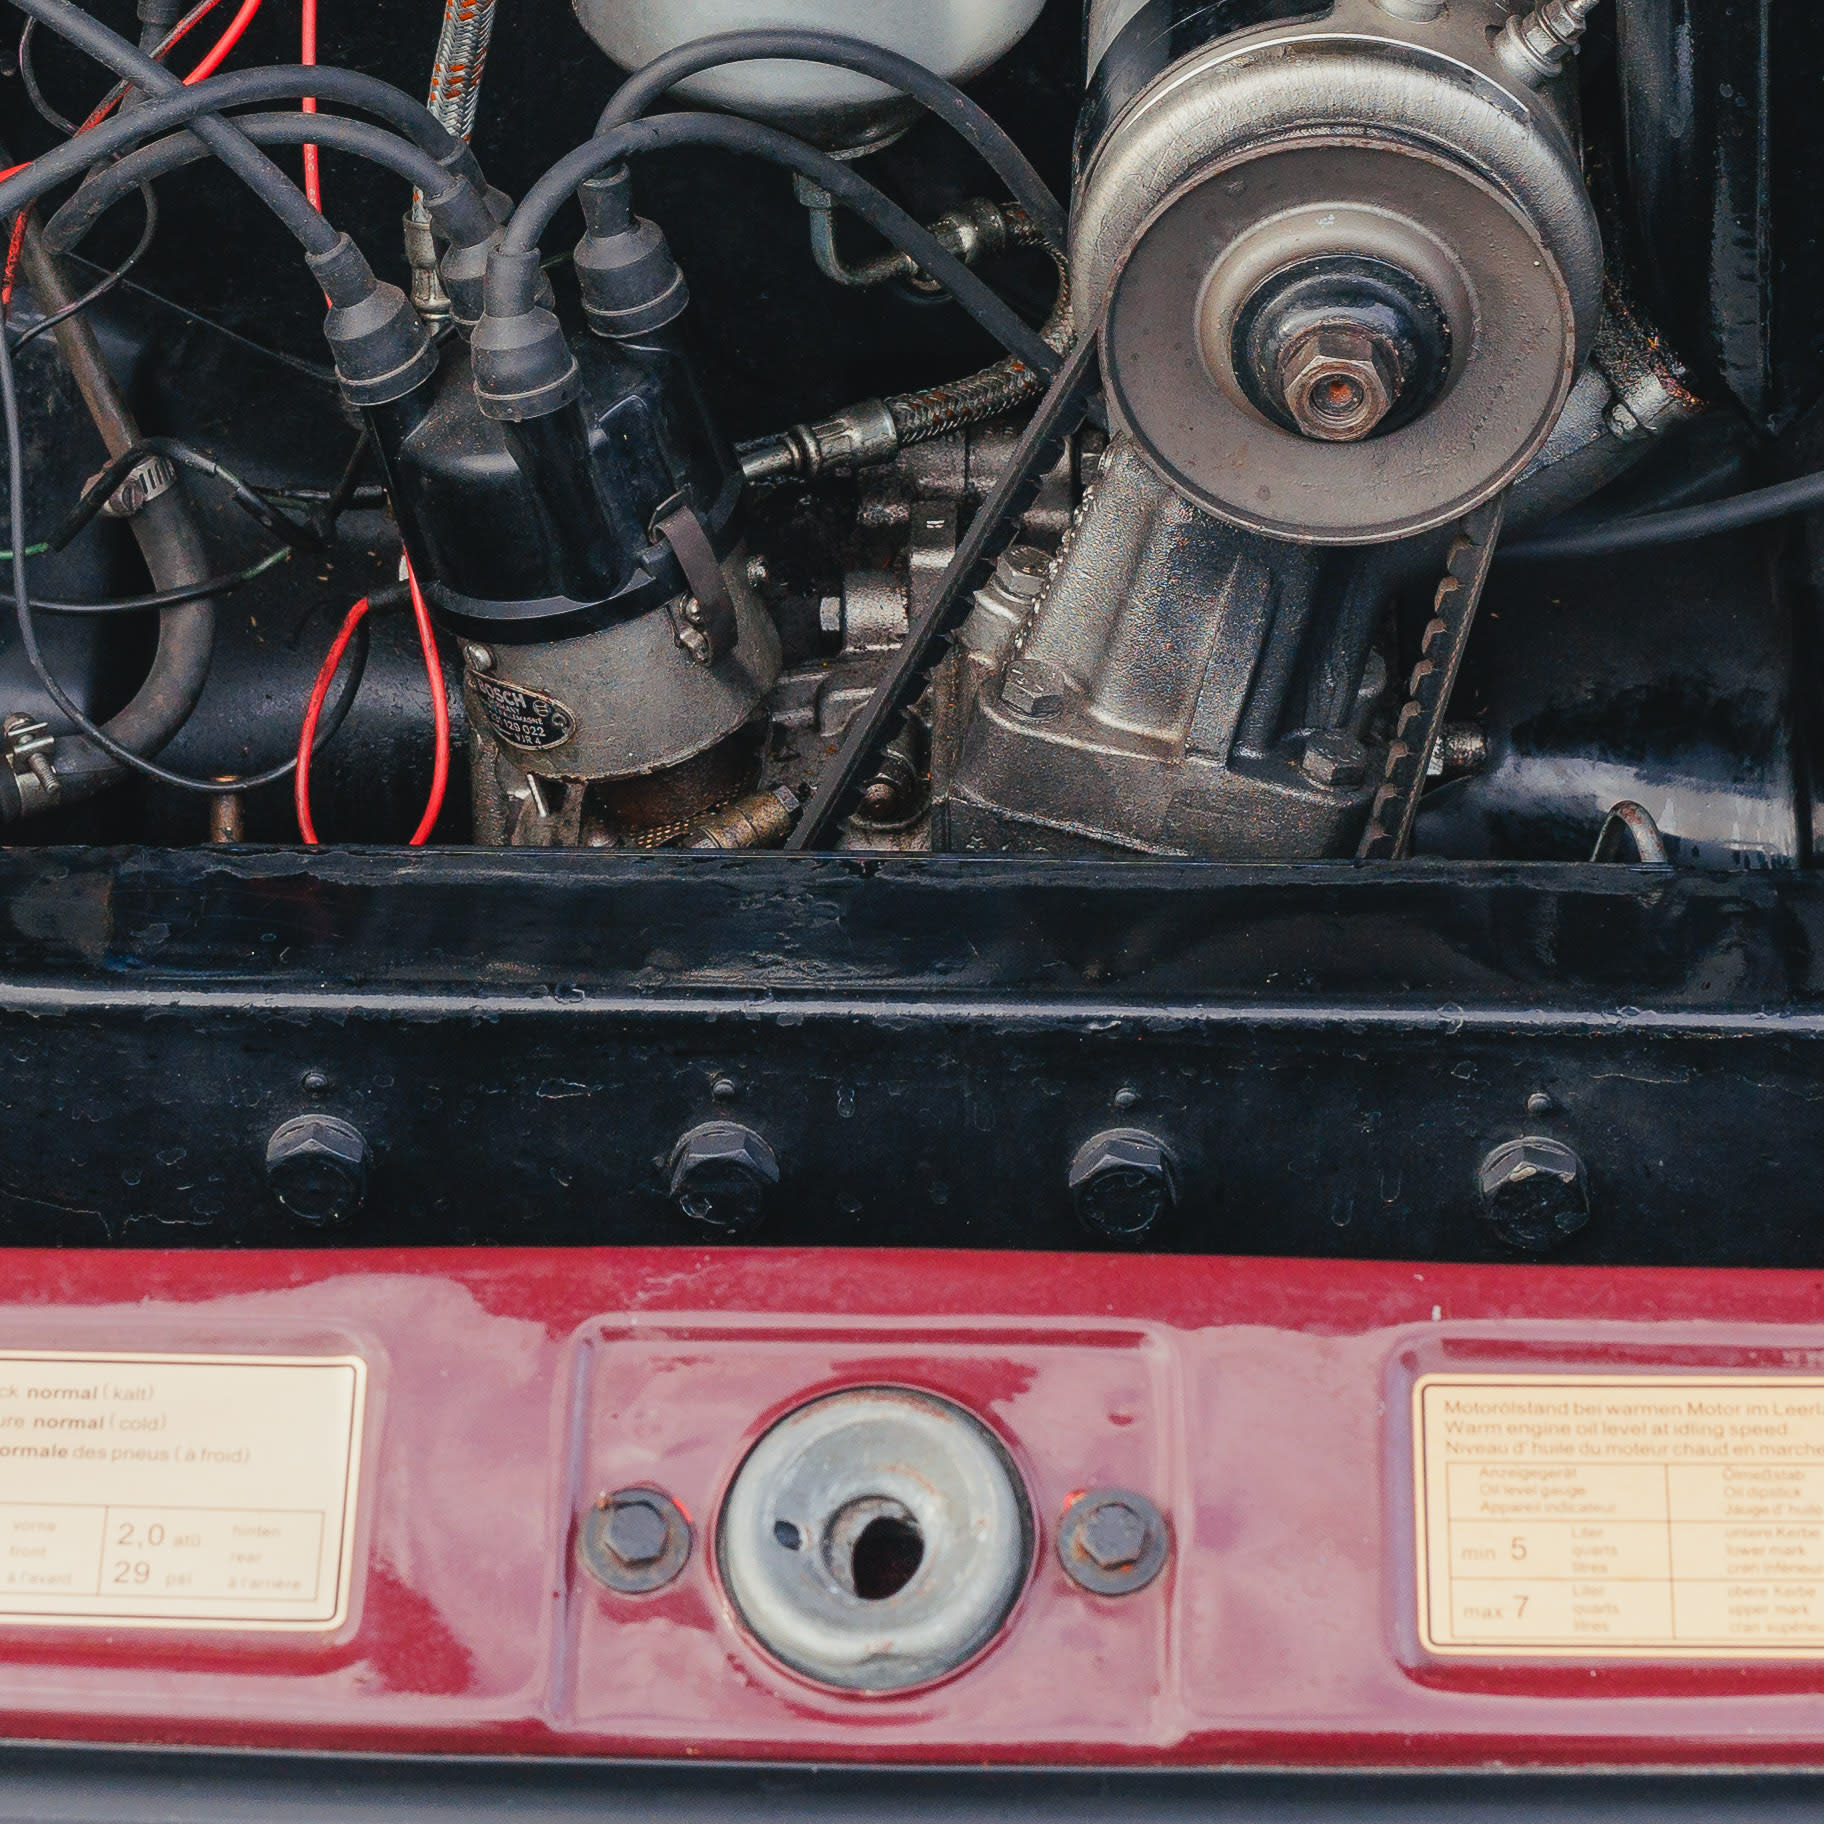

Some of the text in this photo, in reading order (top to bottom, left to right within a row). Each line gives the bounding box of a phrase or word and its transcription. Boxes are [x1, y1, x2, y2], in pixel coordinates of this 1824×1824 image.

[27, 1385, 98, 1401] normal
[1573, 1401, 1602, 1416] bei
[1606, 1403, 1683, 1416] warmen
[1687, 1402, 1741, 1417] Motor
[1746, 1402, 1770, 1417] im
[33, 1415, 104, 1431] normal
[1445, 1420, 1789, 1439] Warm engine oil level at idling speed
[73, 1444, 107, 1461] des
[111, 1447, 169, 1464] pneus
[1445, 1439, 1509, 1455] Niveau
[1579, 1441, 1601, 1455] du
[1605, 1442, 1669, 1456] moteur
[1673, 1441, 1729, 1457] chaud
[1733, 1444, 1755, 1457] en
[118, 1521, 165, 1549] 2,0
[1461, 1535, 1527, 1561] min 5
[113, 1559, 152, 1585] 29
[1463, 1593, 1530, 1619] max 7
